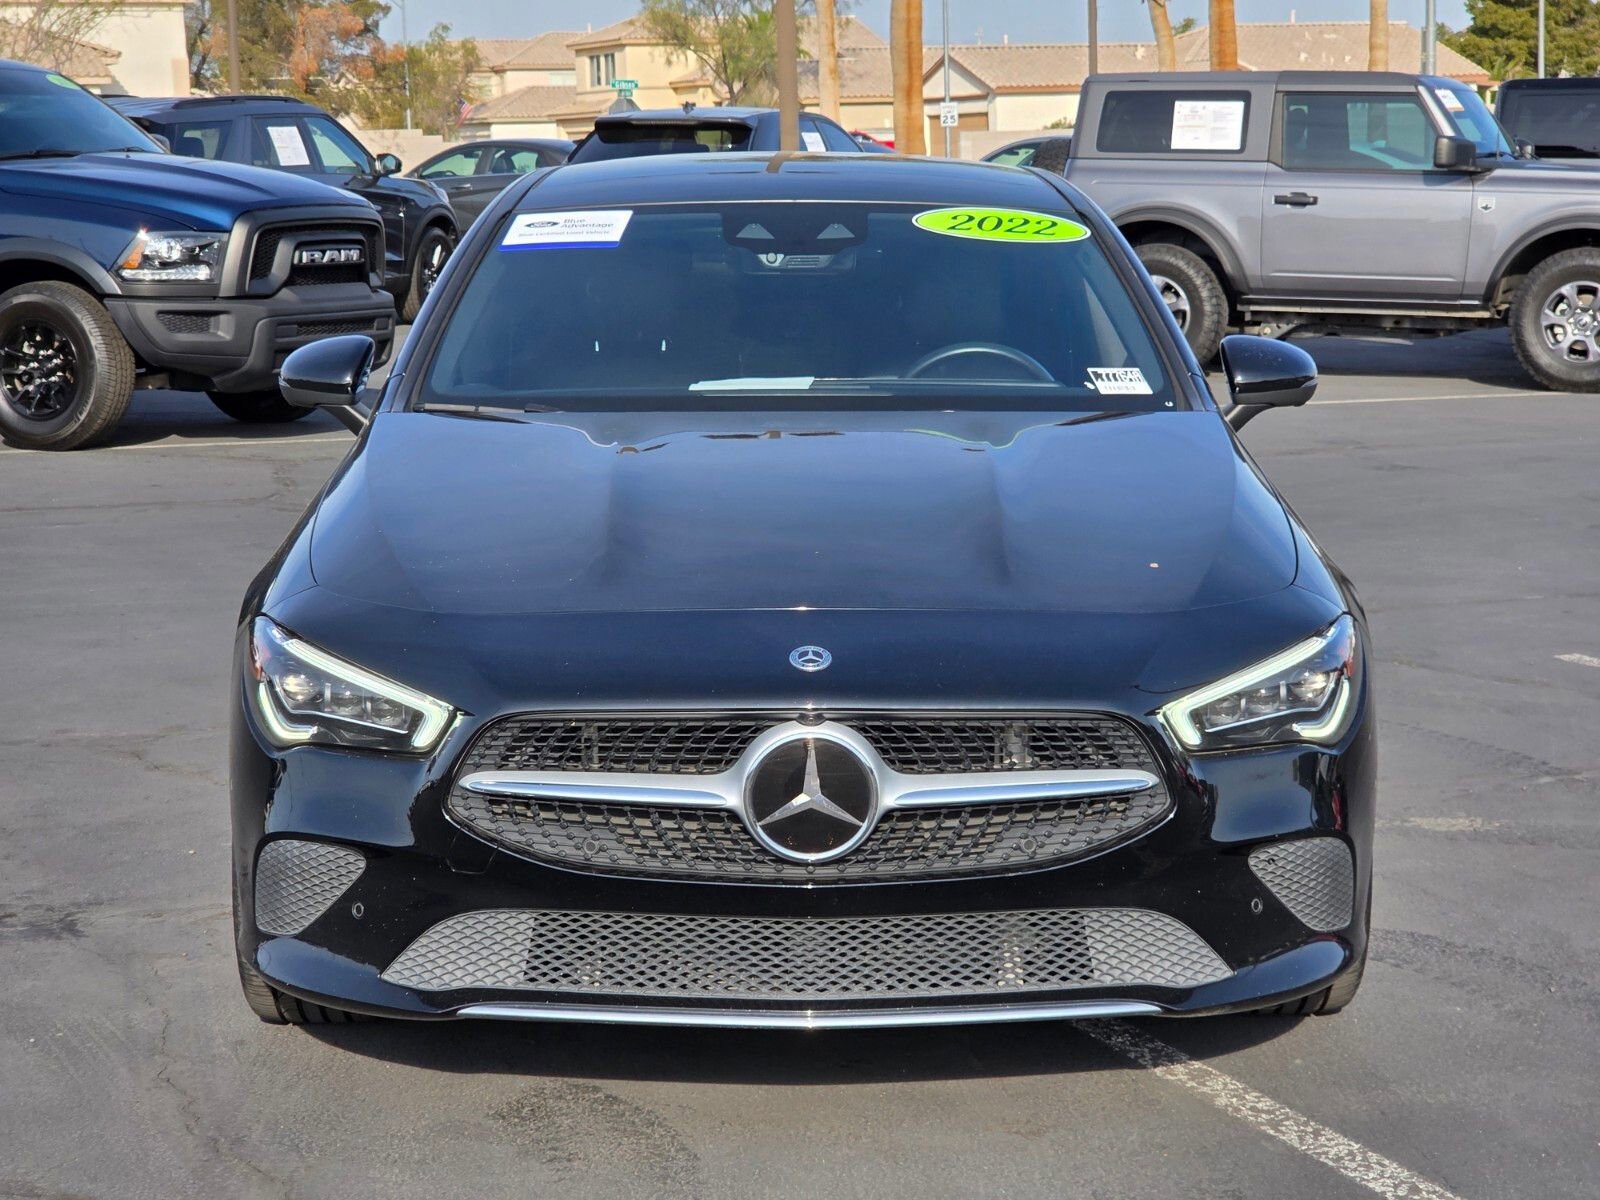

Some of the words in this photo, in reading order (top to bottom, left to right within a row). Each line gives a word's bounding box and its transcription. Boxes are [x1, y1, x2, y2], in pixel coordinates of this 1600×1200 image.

[943, 115, 956, 125] 25
[946, 213, 1059, 237] 2022
[302, 249, 361, 264] RAM
